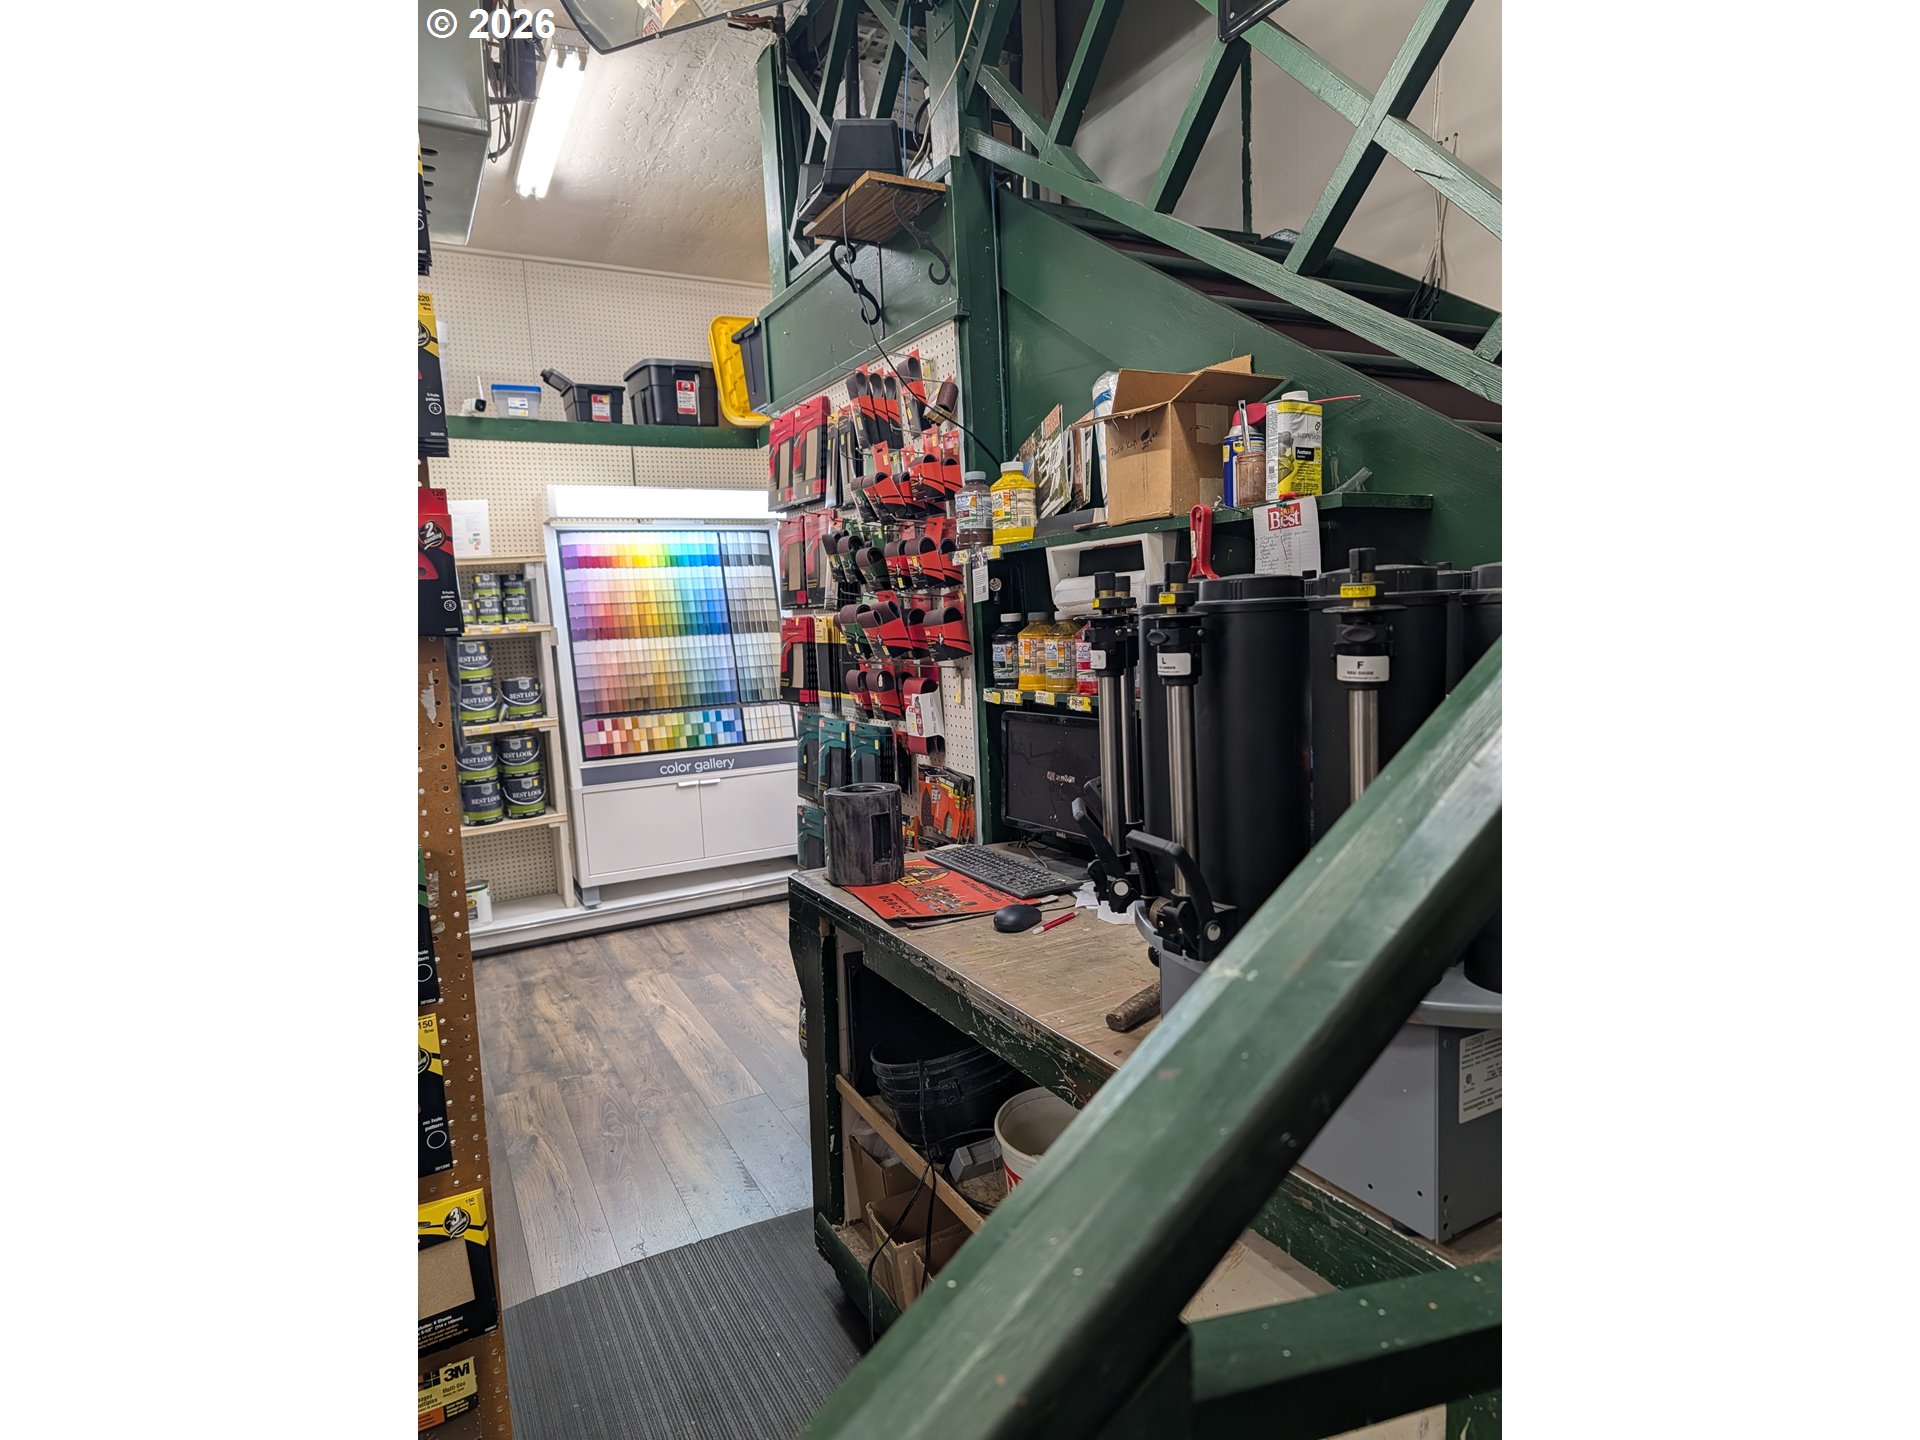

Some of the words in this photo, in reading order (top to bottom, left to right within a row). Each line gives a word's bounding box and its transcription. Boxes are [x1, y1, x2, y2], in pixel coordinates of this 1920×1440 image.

[1269, 509, 1300, 530] Best
[1162, 657, 1167, 665] L
[1357, 661, 1364, 669] F
[660, 761, 691, 775] color
[694, 758, 735, 773] gallery
[418, 1020, 433, 1029] 150
[431, 1116, 443, 1125] hole
[424, 1122, 444, 1132] pattern
[444, 1362, 470, 1382] 3M
